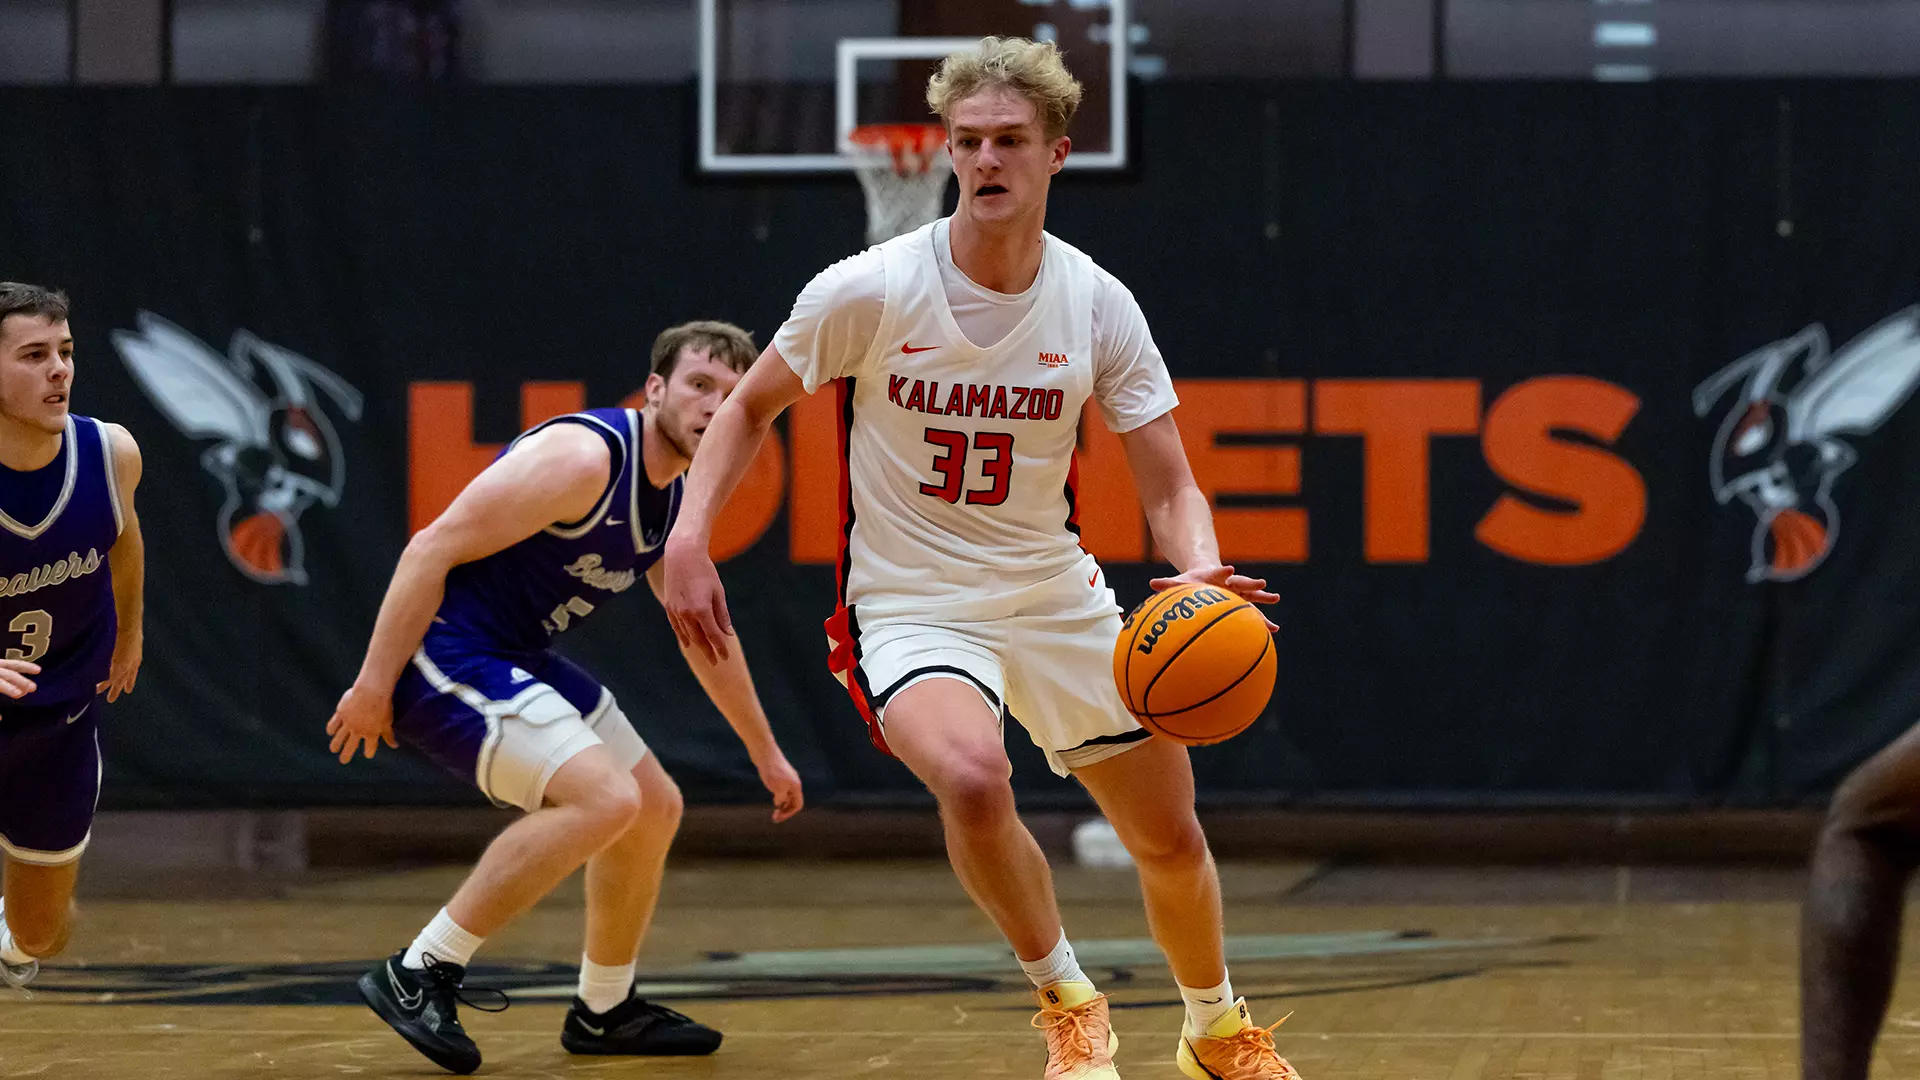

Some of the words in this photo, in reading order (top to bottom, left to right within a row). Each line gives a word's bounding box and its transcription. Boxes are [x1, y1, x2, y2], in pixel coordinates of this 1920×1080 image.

[1038, 352, 1069, 363] MIAA
[888, 374, 1064, 420] KALAMAZOO
[408, 375, 1647, 565] HETS
[919, 427, 1015, 506] 33
[5, 609, 53, 662] 3
[1137, 588, 1230, 655] Wilson
